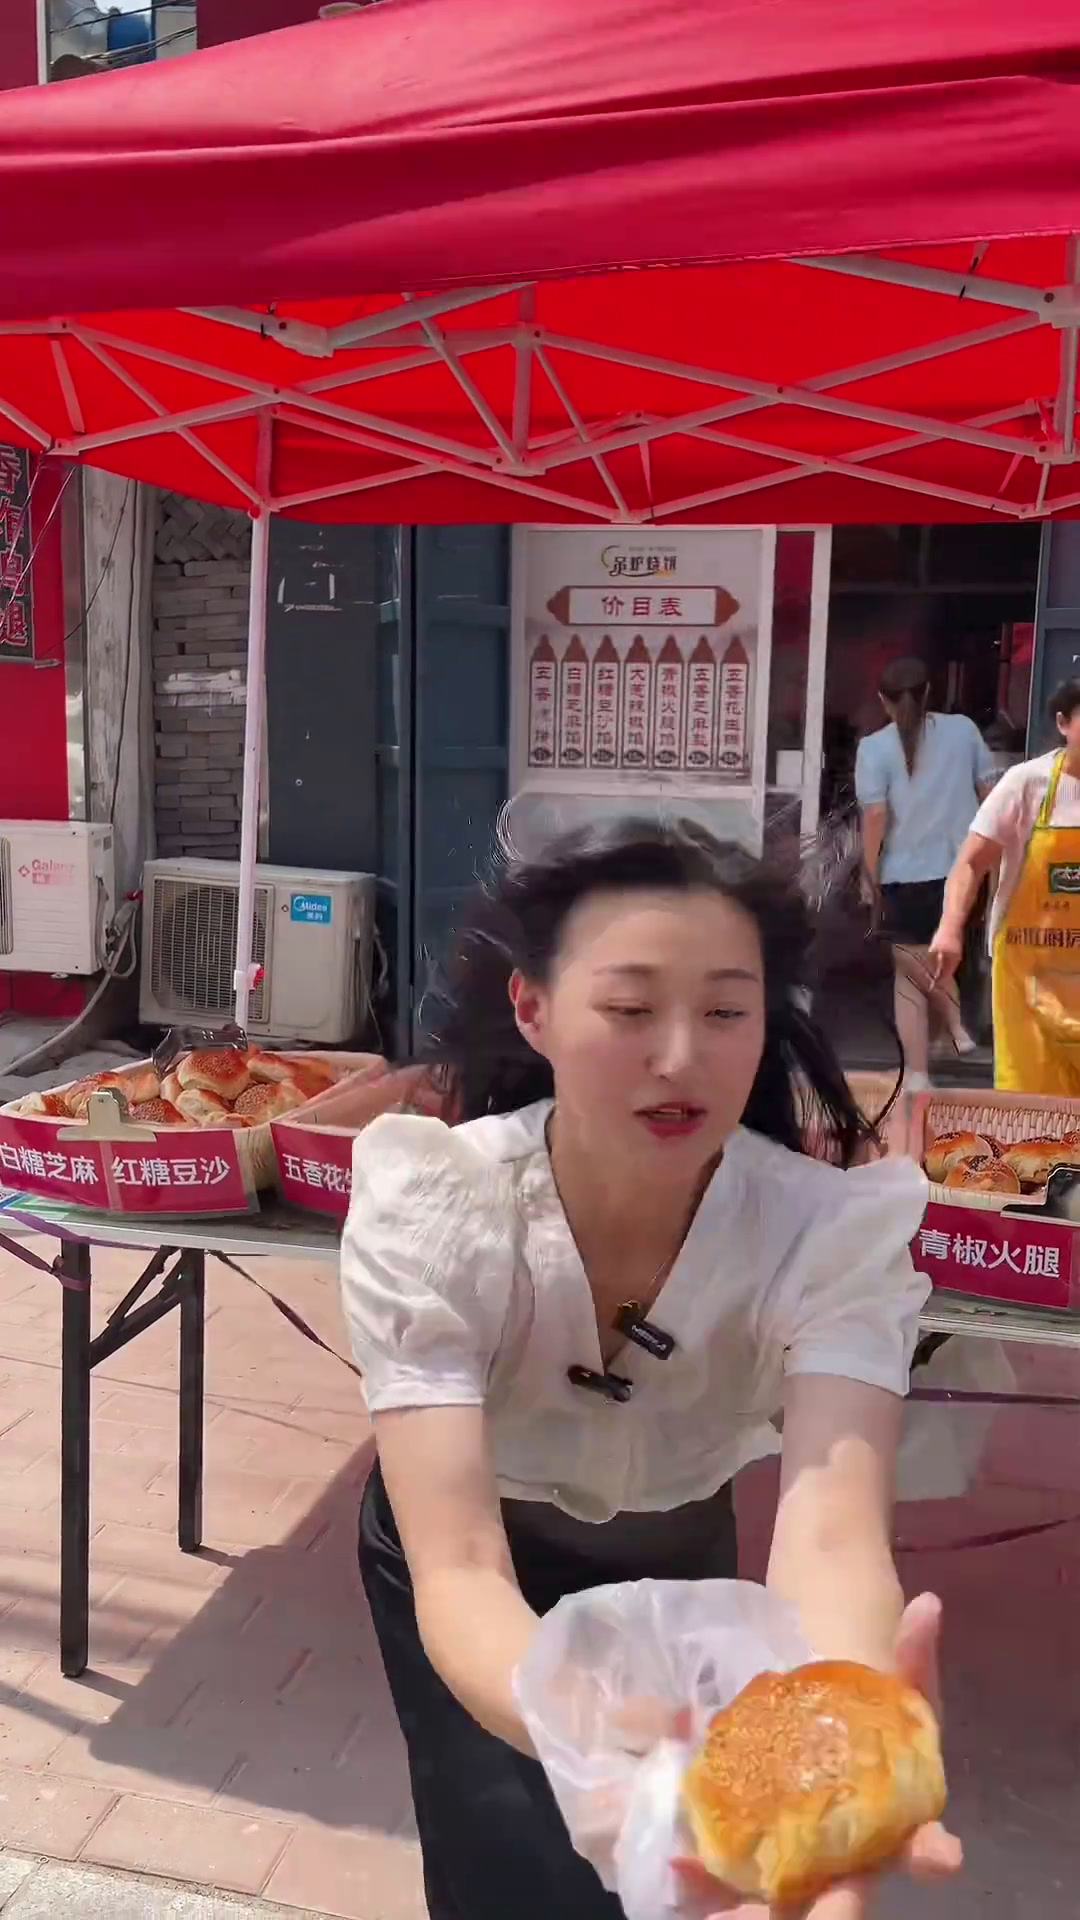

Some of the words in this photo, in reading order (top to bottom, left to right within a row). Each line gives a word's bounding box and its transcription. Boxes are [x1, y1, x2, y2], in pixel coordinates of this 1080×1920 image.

[601, 595, 682, 617] 价目表
[0, 1142, 99, 1185] 白糖芝麻
[111, 1155, 231, 1187] 红糖豆沙
[919, 1229, 1060, 1278] 青椒火腿
